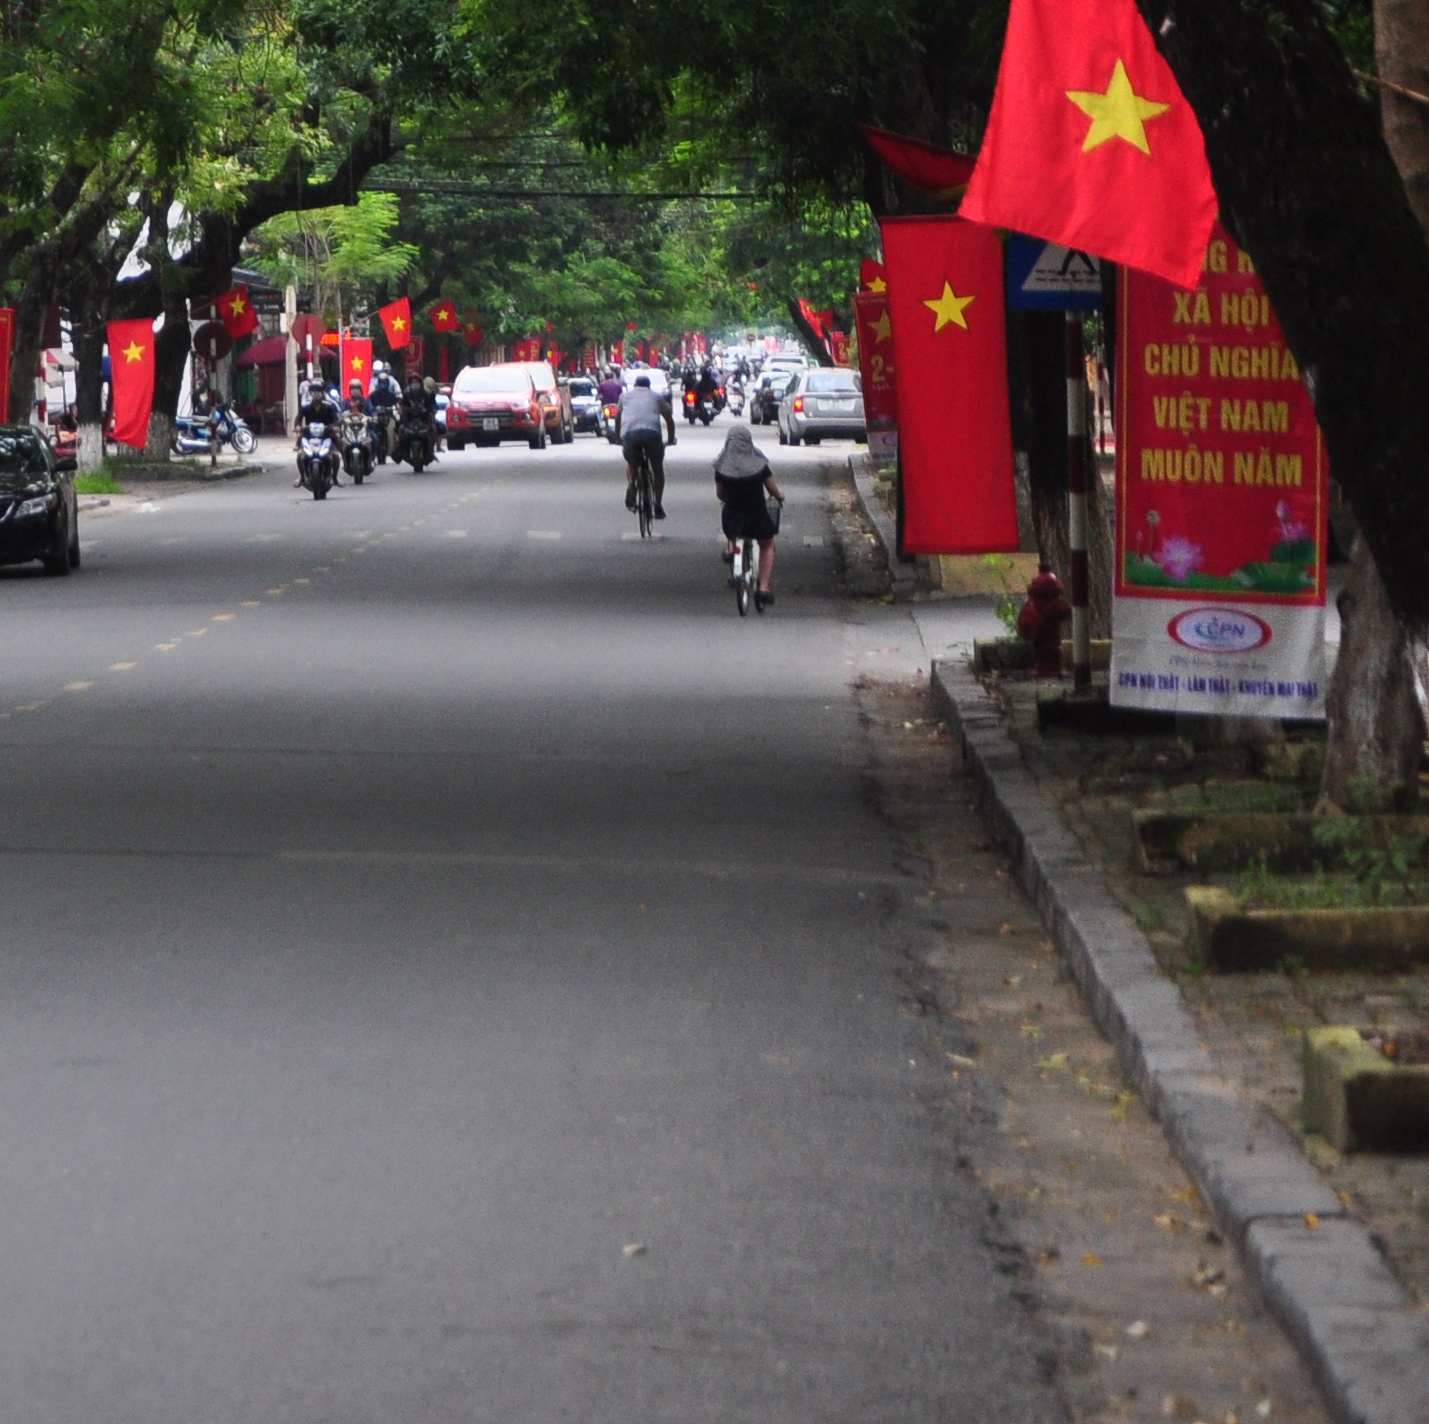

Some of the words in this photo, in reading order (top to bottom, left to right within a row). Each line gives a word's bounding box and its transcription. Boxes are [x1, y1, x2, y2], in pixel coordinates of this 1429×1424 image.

[1173, 287, 1212, 325] XÃ
[1220, 287, 1269, 333] HỘI
[1144, 334, 1200, 378] CHỦ
[1208, 340, 1301, 380] NGHĨA
[1152, 391, 1212, 436] VIỆT
[1220, 398, 1290, 433] NAM
[1140, 443, 1225, 484] MUÔN
[1233, 446, 1303, 487] NĂM
